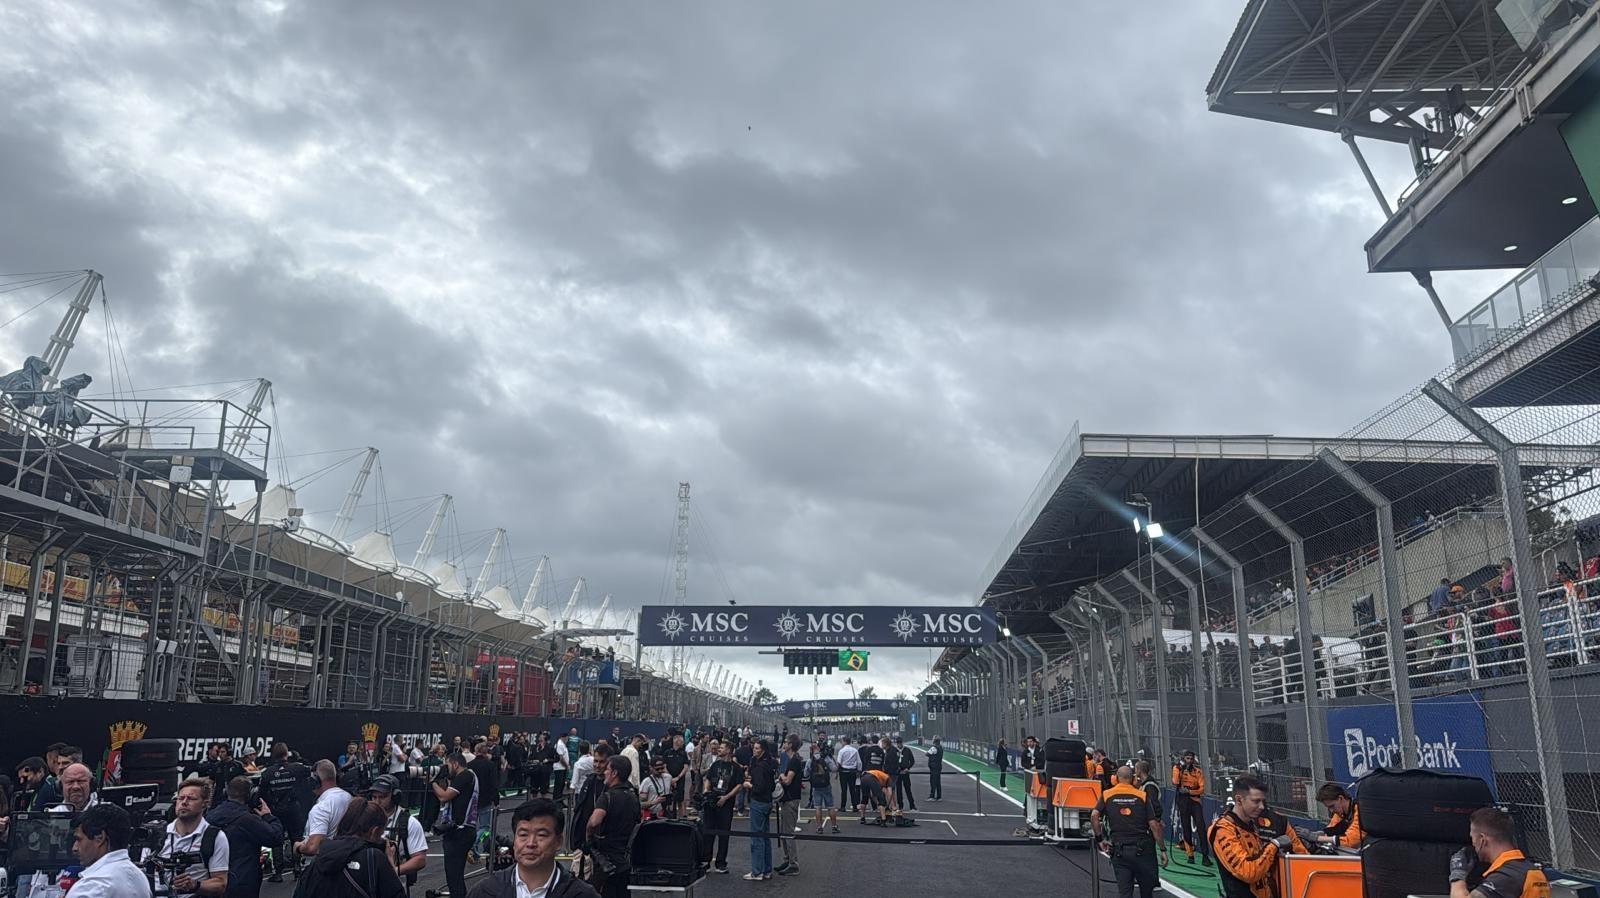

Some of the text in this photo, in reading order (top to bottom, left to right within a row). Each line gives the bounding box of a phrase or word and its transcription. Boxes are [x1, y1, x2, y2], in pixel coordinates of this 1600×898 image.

[690, 612, 749, 633] MSC
[806, 612, 865, 633] MSC
[922, 613, 982, 633] MSC
[256, 736, 273, 758] DE
[1366, 736, 1402, 768] Port
